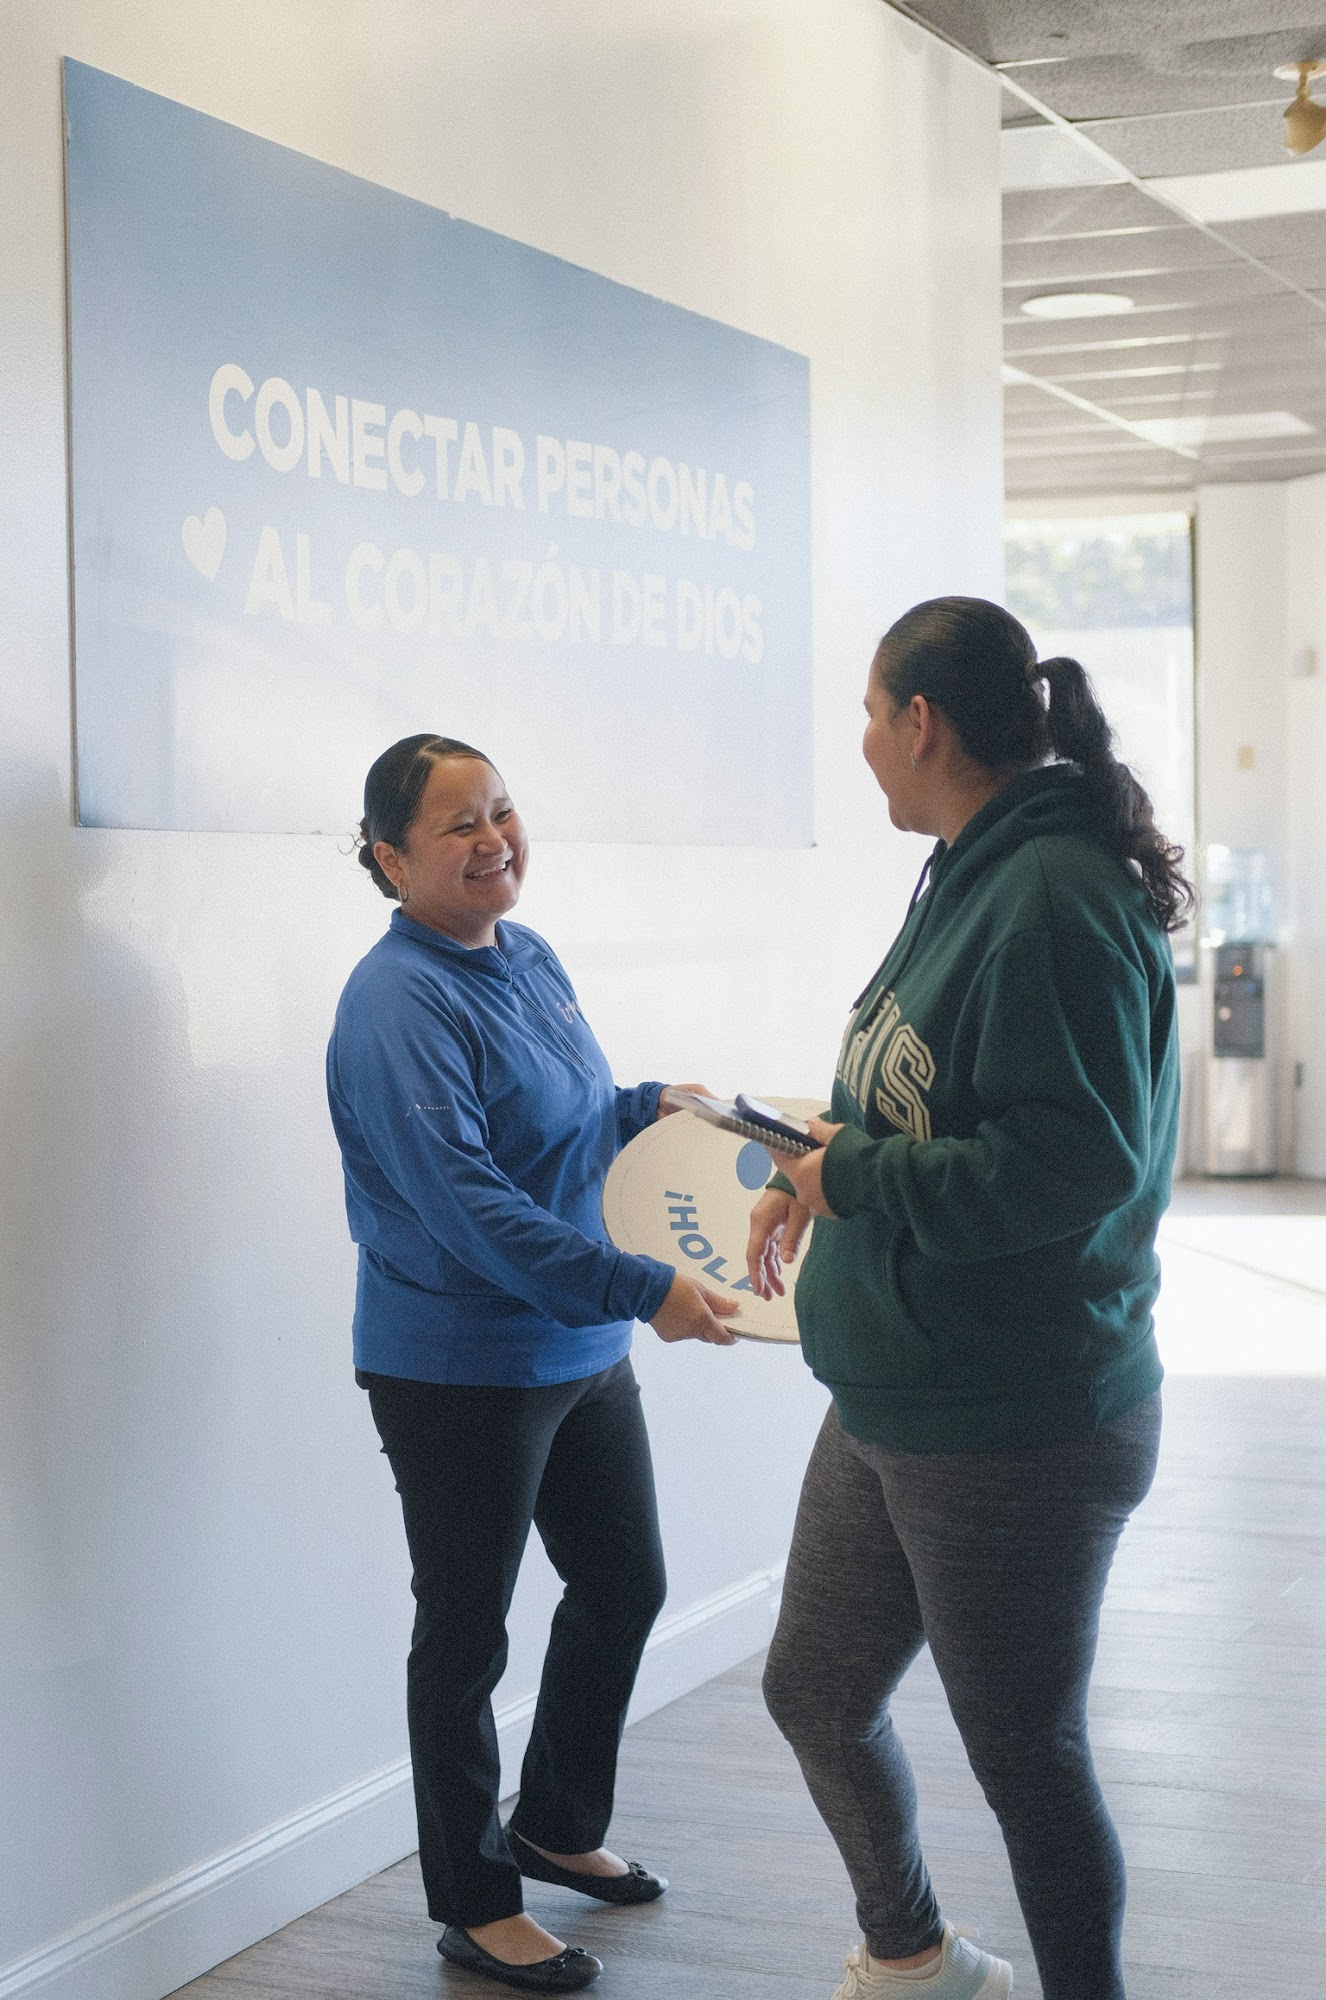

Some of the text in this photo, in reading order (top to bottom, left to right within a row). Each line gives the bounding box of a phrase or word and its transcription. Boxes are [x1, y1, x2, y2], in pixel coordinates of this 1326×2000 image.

[208, 363, 757, 551] CONECTAR PERSONAS
[245, 525, 765, 665] AL CORAZÓN DE DIOS
